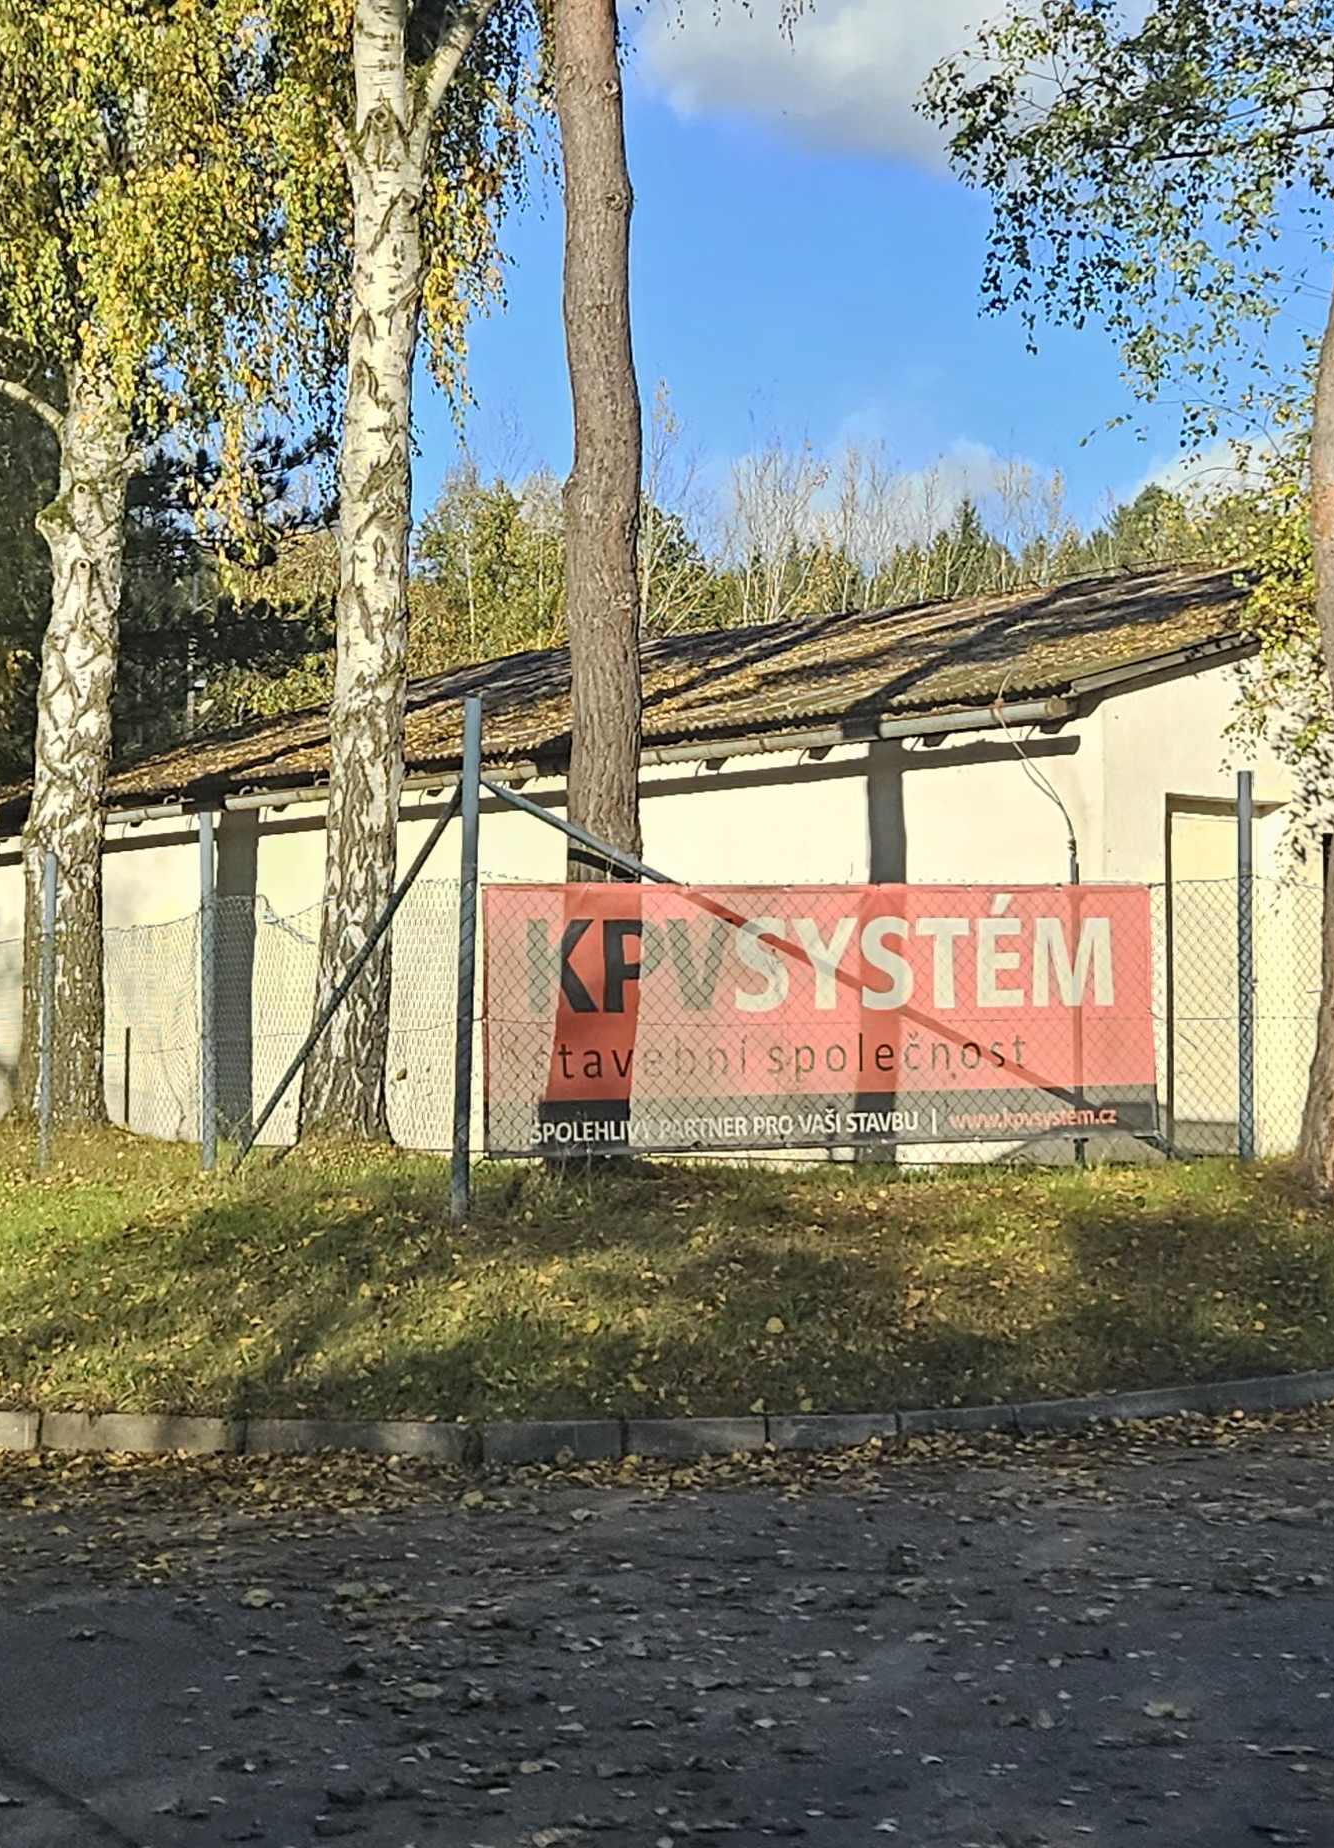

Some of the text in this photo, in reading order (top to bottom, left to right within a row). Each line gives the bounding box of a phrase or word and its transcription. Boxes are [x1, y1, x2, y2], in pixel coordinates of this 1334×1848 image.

[524, 893, 1115, 1015] KPVSYSTÉM
[768, 1032, 1027, 1081] společnost
[530, 1107, 1118, 1144] SPOLEHLIVÝ PARTNER PRO VAŠI STAVBU www.kpvsystem.cz
